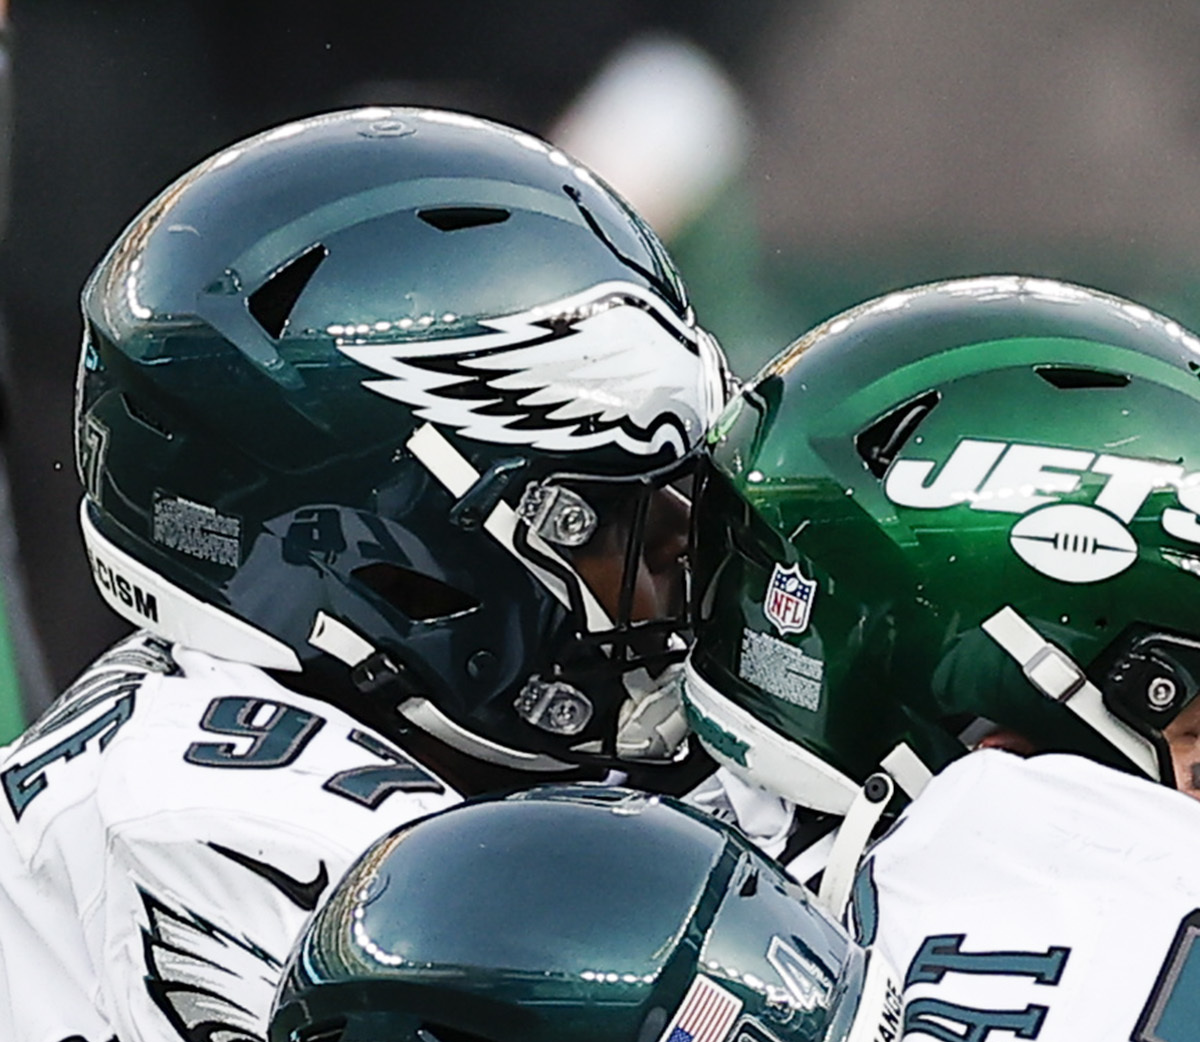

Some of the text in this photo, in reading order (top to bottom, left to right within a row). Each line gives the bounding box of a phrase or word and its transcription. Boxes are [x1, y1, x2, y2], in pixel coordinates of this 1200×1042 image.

[88, 555, 159, 623] CISM
[770, 590, 802, 625] NFL
[183, 695, 446, 811] 97
